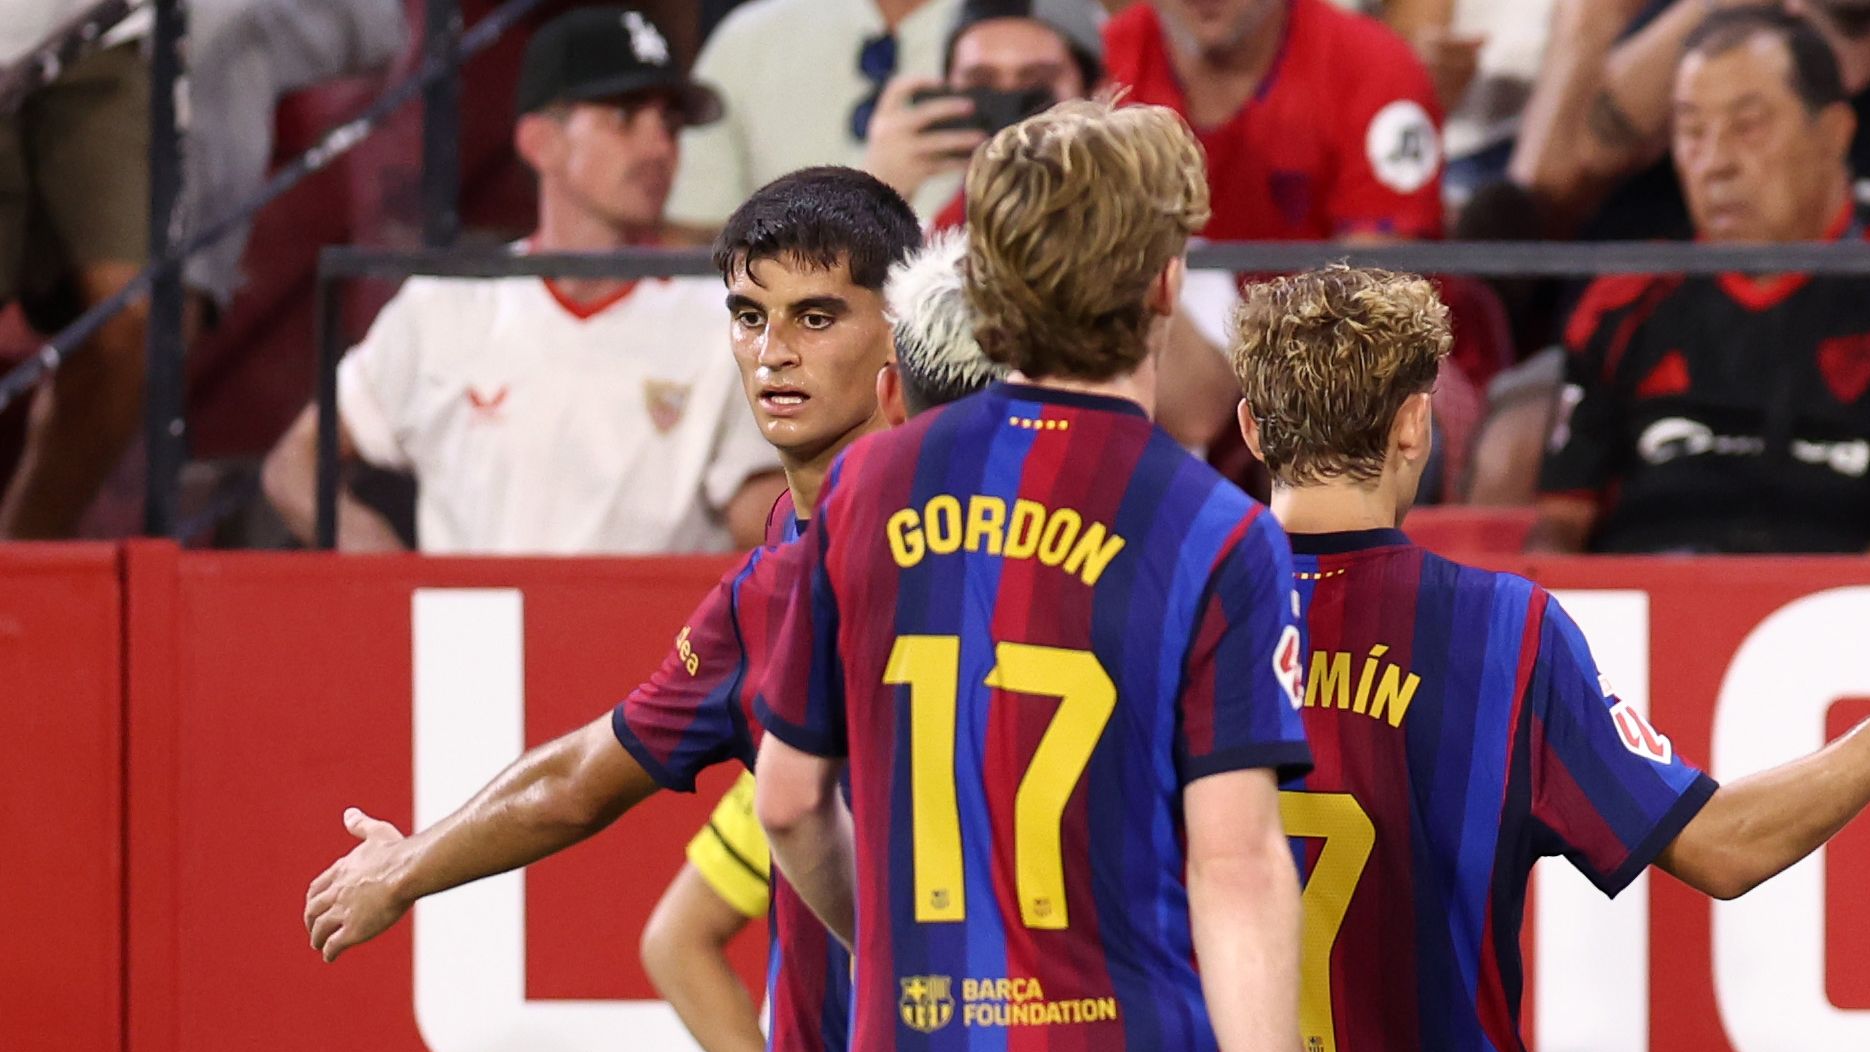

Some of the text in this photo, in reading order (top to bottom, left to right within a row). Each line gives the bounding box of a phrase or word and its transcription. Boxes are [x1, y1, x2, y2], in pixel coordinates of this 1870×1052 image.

[886, 494, 1126, 586] GORDON
[675, 624, 700, 677] dea
[1304, 644, 1421, 729] MÍN
[882, 635, 1118, 930] 17
[961, 977, 1044, 1003] BARÇA
[962, 997, 1118, 1027] FOUNDATION
